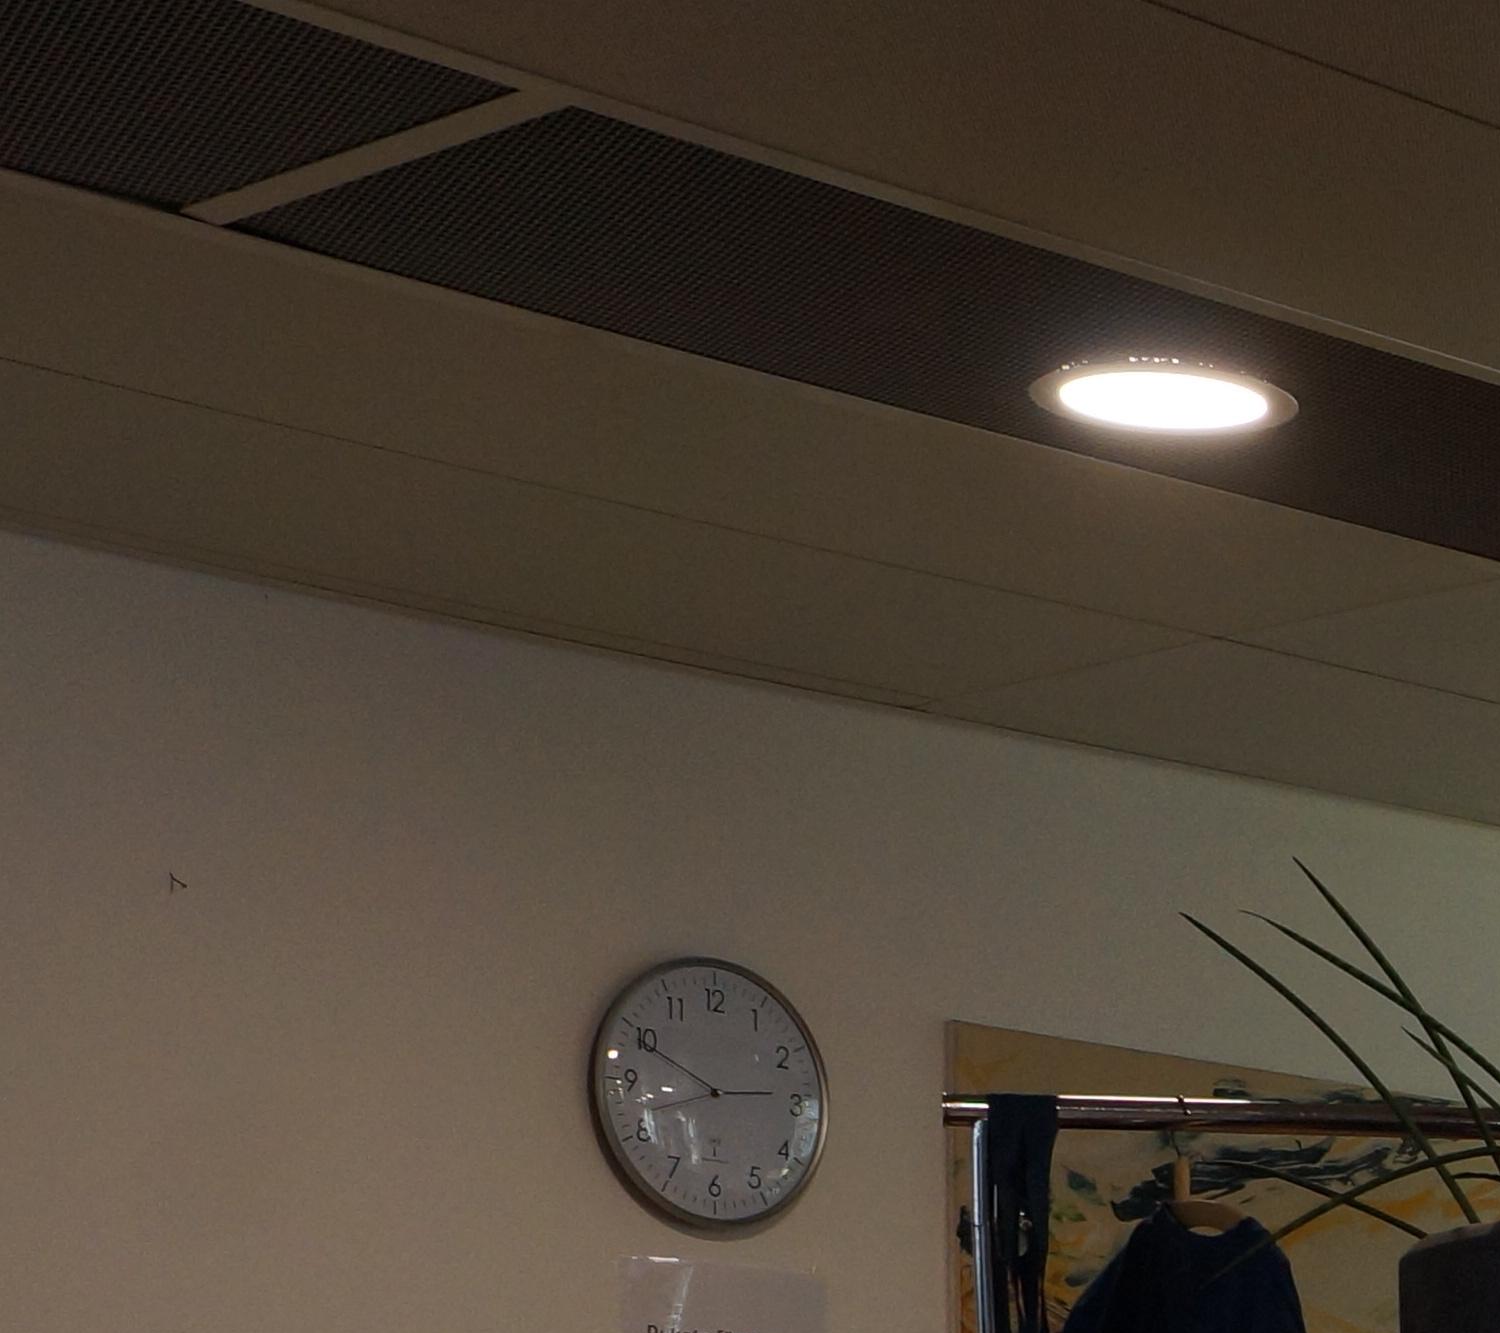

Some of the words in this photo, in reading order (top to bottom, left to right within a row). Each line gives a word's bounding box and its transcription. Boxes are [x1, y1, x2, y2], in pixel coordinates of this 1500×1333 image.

[666, 997, 686, 1021] 11
[705, 988, 726, 1014] 12
[750, 1009, 759, 1032] 1
[636, 1028, 658, 1052] 10
[776, 1046, 790, 1069] 2
[624, 1069, 638, 1092] 9
[777, 1139, 791, 1161] 4
[667, 1155, 681, 1179] 7
[749, 1166, 762, 1189] 5
[708, 1175, 722, 1198] 6
